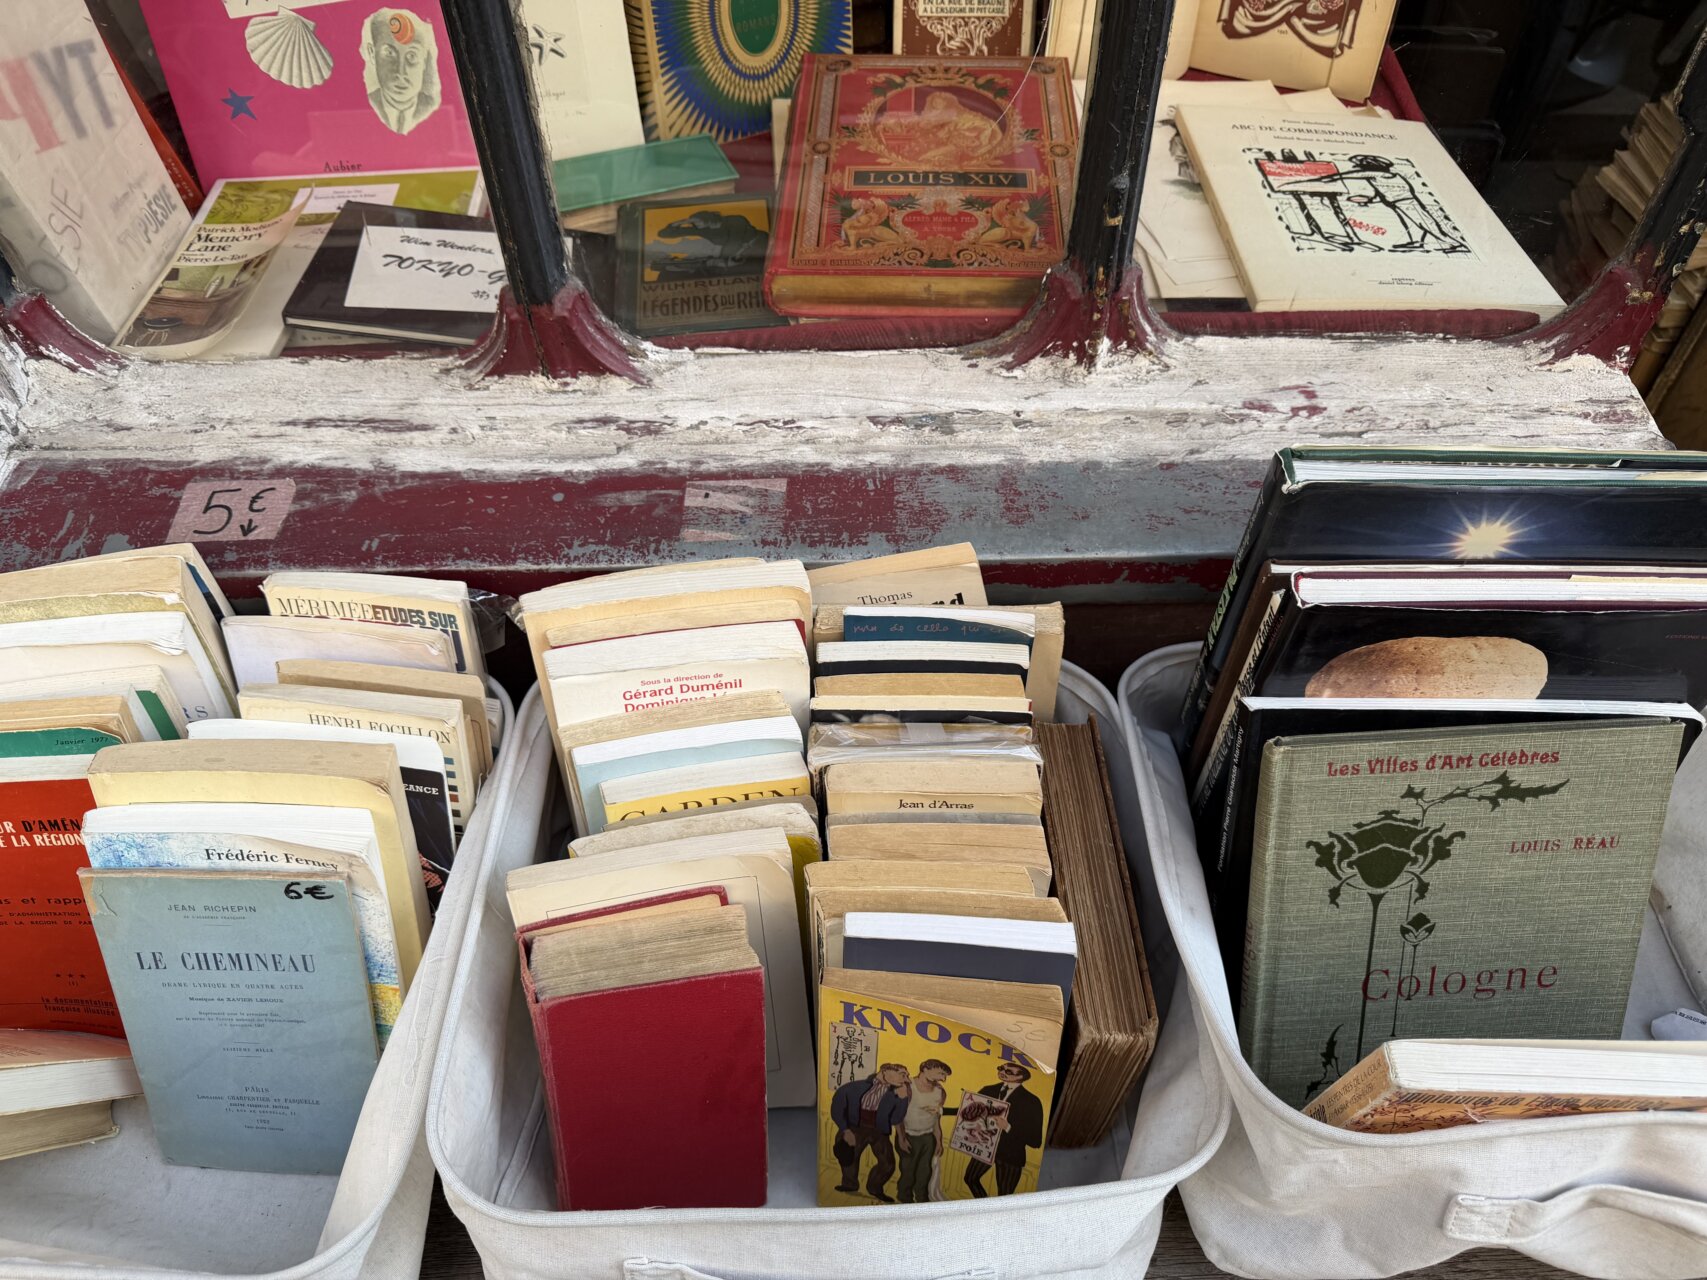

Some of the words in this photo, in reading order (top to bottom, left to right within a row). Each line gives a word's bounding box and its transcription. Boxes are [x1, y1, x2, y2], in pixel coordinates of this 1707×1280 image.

[1231, 123, 1255, 131] ABC
[1279, 126, 1398, 141] CORRESPONDANCE
[323, 160, 363, 173] Aubier
[868, 172, 955, 185] LOUIS
[968, 173, 1014, 186] XIV
[194, 229, 268, 244] Memory
[197, 225, 236, 234] Patrick
[184, 243, 232, 252] Lane
[400, 235, 432, 247] Wim
[437, 239, 495, 255] Wenders
[642, 294, 719, 318] LÉGENDES
[857, 591, 913, 605] Thomas
[276, 595, 374, 620] MÉRIMÉE
[372, 604, 427, 627] ETUDES
[427, 610, 459, 630] SUR
[673, 673, 711, 682] direction
[622, 686, 673, 700] Gérard
[680, 679, 743, 694] Duménil
[55, 738, 86, 746] Janvier
[1233, 725, 1245, 765] Martigny
[1326, 761, 1361, 777] Les
[1366, 756, 1419, 774] Villes
[1425, 752, 1474, 771] d'Art
[897, 799, 924, 809] Jean
[928, 800, 974, 809] d'Arras
[11, 835, 31, 848] LA
[33, 833, 85, 847] RÉGION
[1509, 839, 1561, 854] LOUIS
[1572, 834, 1621, 850] RÉAU
[205, 848, 279, 863] Frédéric
[284, 853, 339, 872] Ferney
[284, 881, 335, 900] 6€
[22, 897, 36, 905] et
[168, 904, 196, 912] JEAN
[204, 904, 257, 913] RICHEPIN
[135, 951, 168, 971] LE
[181, 951, 316, 974] CHEMINEAU
[1362, 965, 1558, 1001] Cologne
[839, 1000, 1038, 1070] KNOCK
